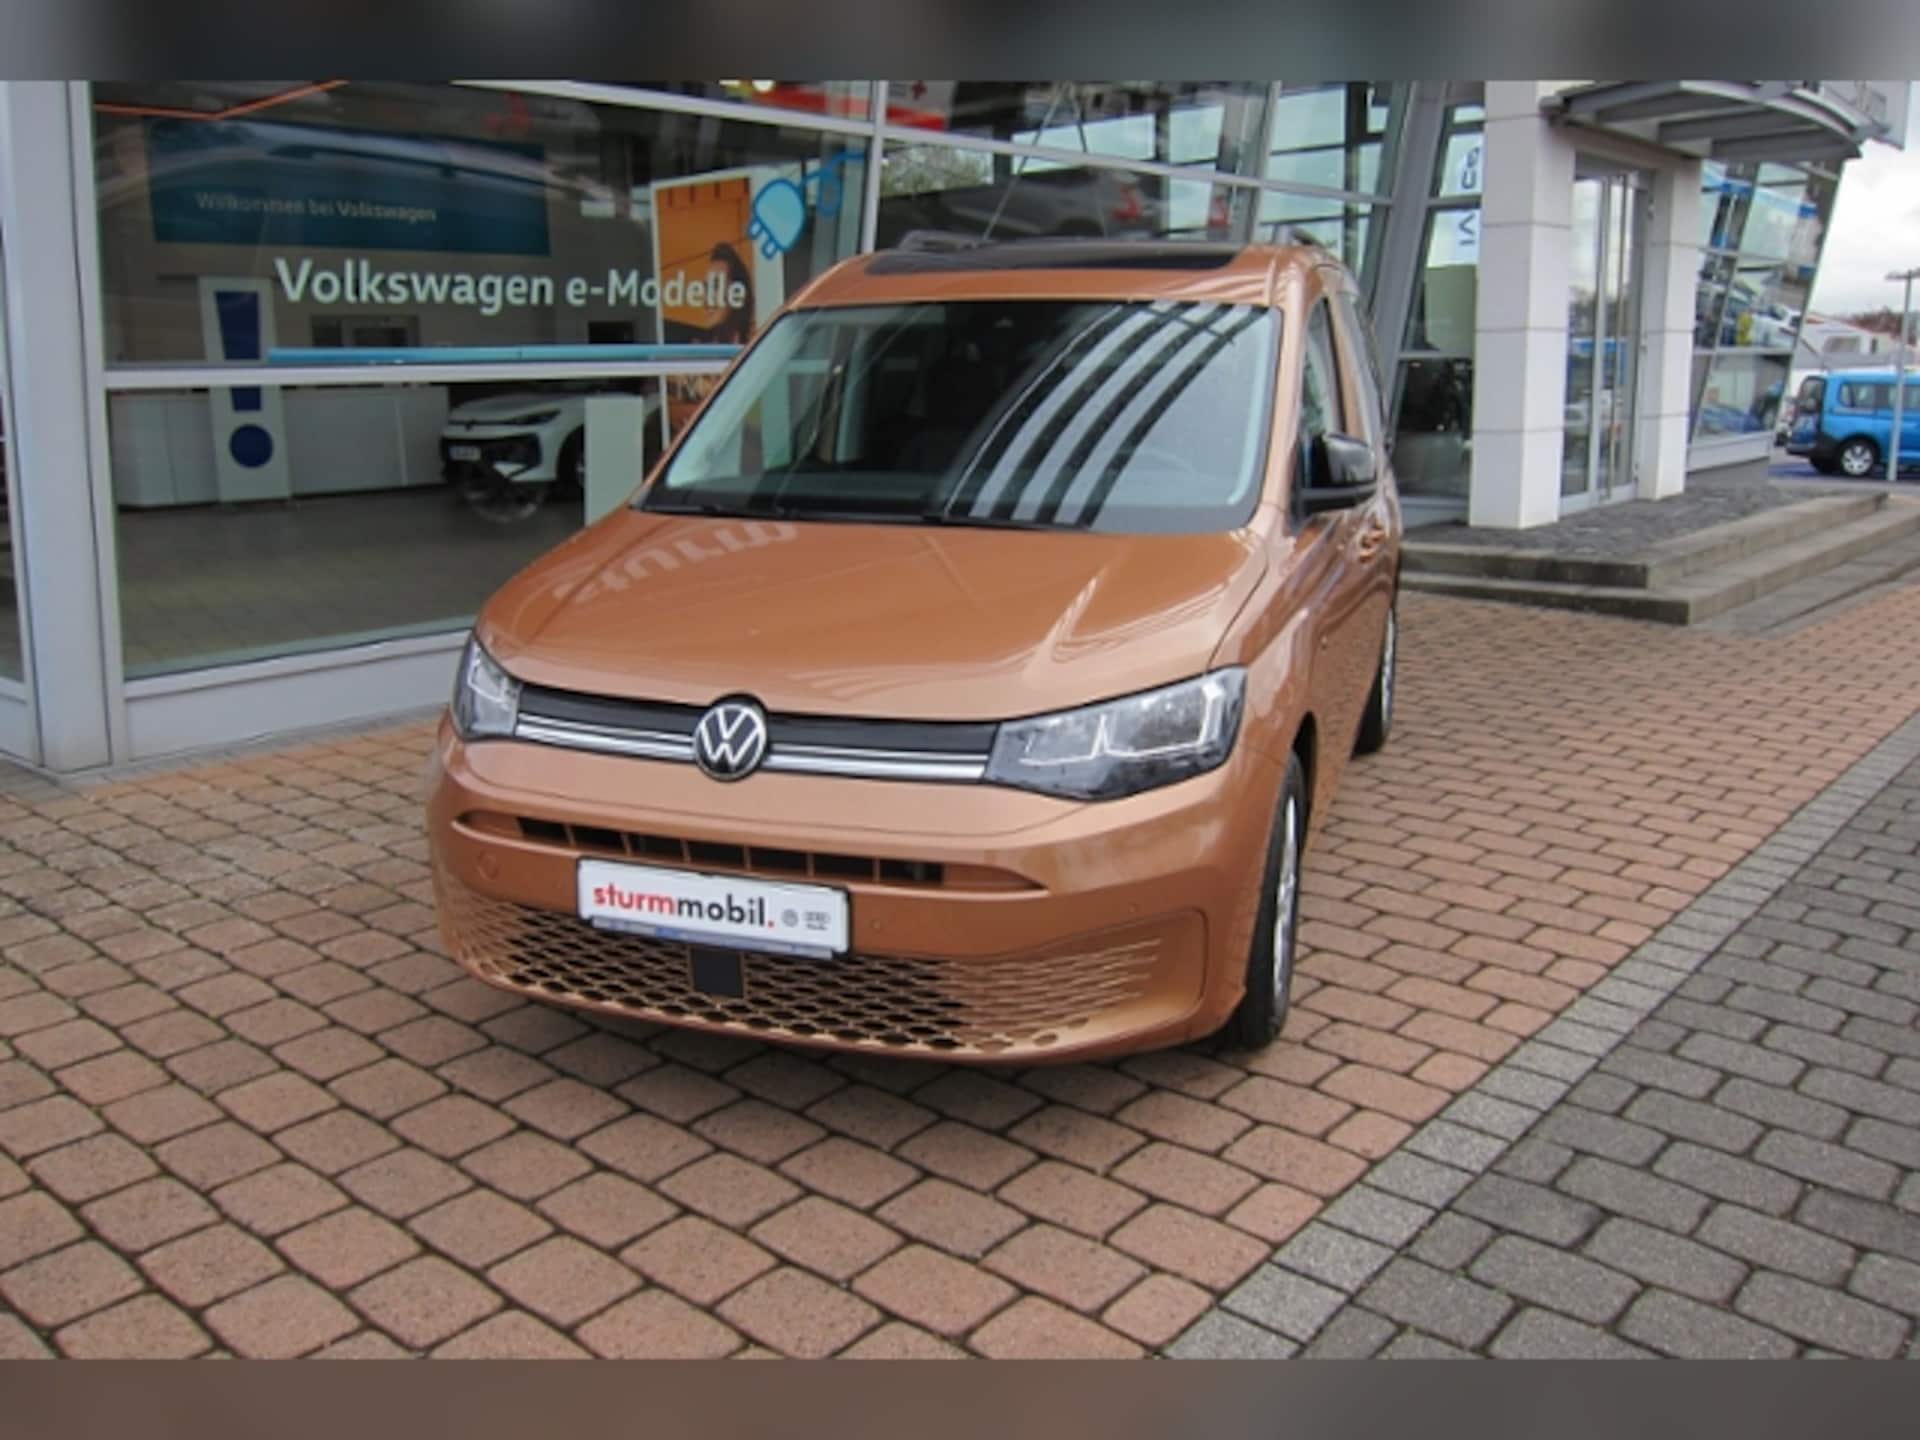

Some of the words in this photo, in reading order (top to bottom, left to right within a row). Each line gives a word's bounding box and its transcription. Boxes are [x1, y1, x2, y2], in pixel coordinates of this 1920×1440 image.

[335, 199, 437, 223] Volkswagen
[274, 257, 554, 316] Volkswagen
[565, 268, 747, 310] e-Modelle
[592, 883, 775, 929] sturmmobil.
